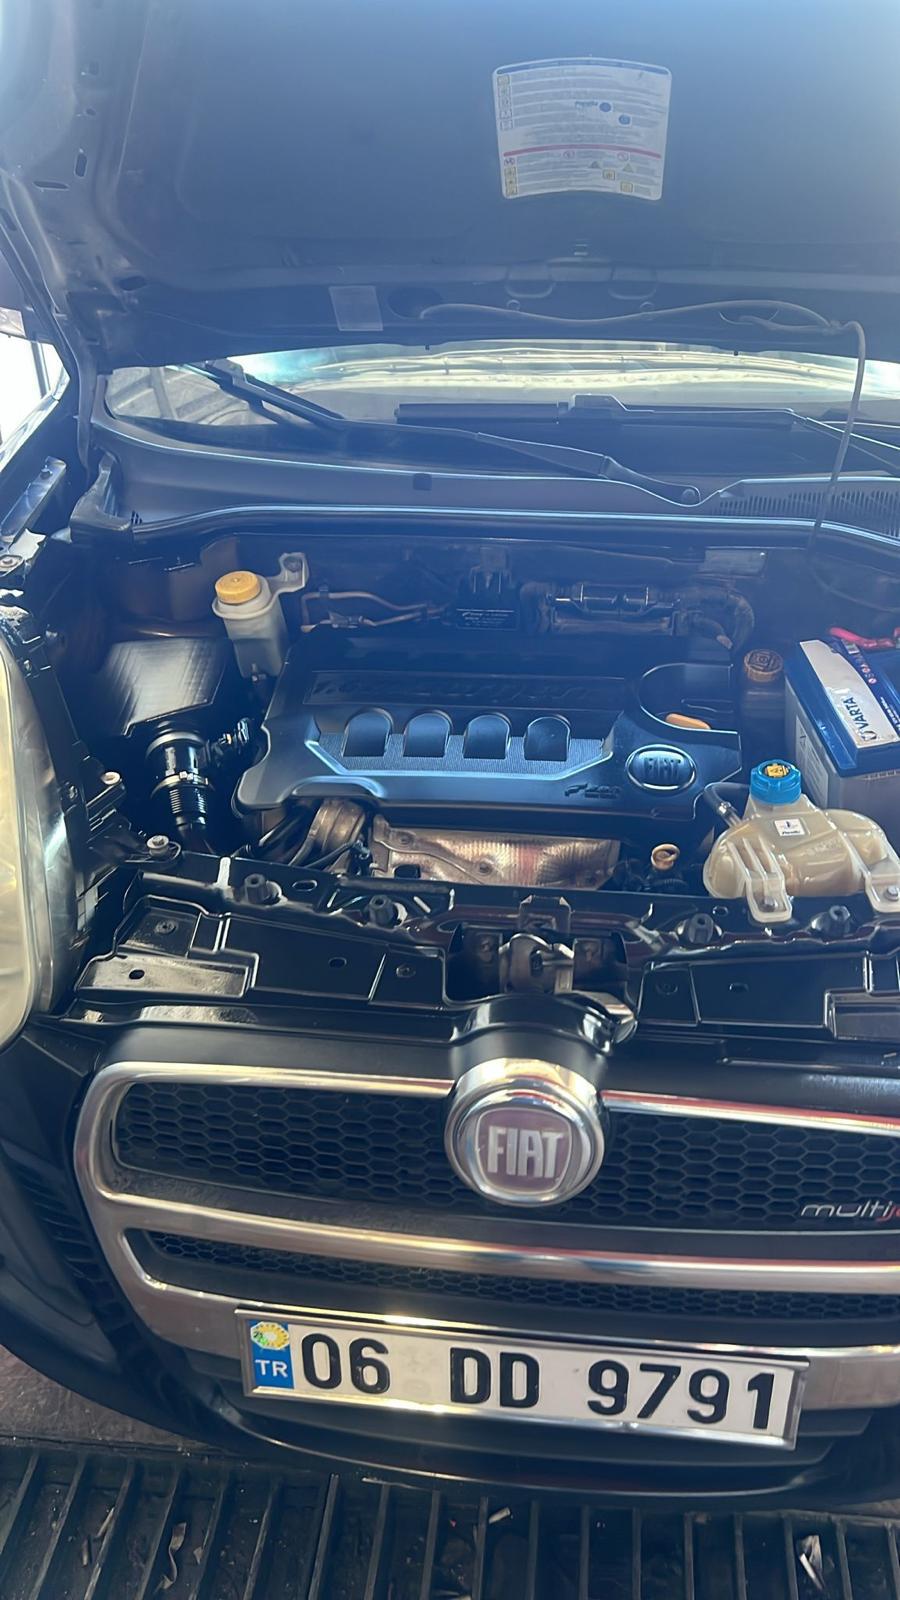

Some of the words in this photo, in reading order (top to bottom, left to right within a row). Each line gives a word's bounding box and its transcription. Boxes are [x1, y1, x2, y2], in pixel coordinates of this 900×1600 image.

[843, 696, 869, 732] VARTA
[643, 757, 682, 779] FIAT
[487, 1125, 565, 1179] FIAT
[255, 1359, 288, 1378] TR
[301, 1333, 391, 1394] 06
[450, 1346, 540, 1409] DD
[587, 1360, 777, 1430] 9791
